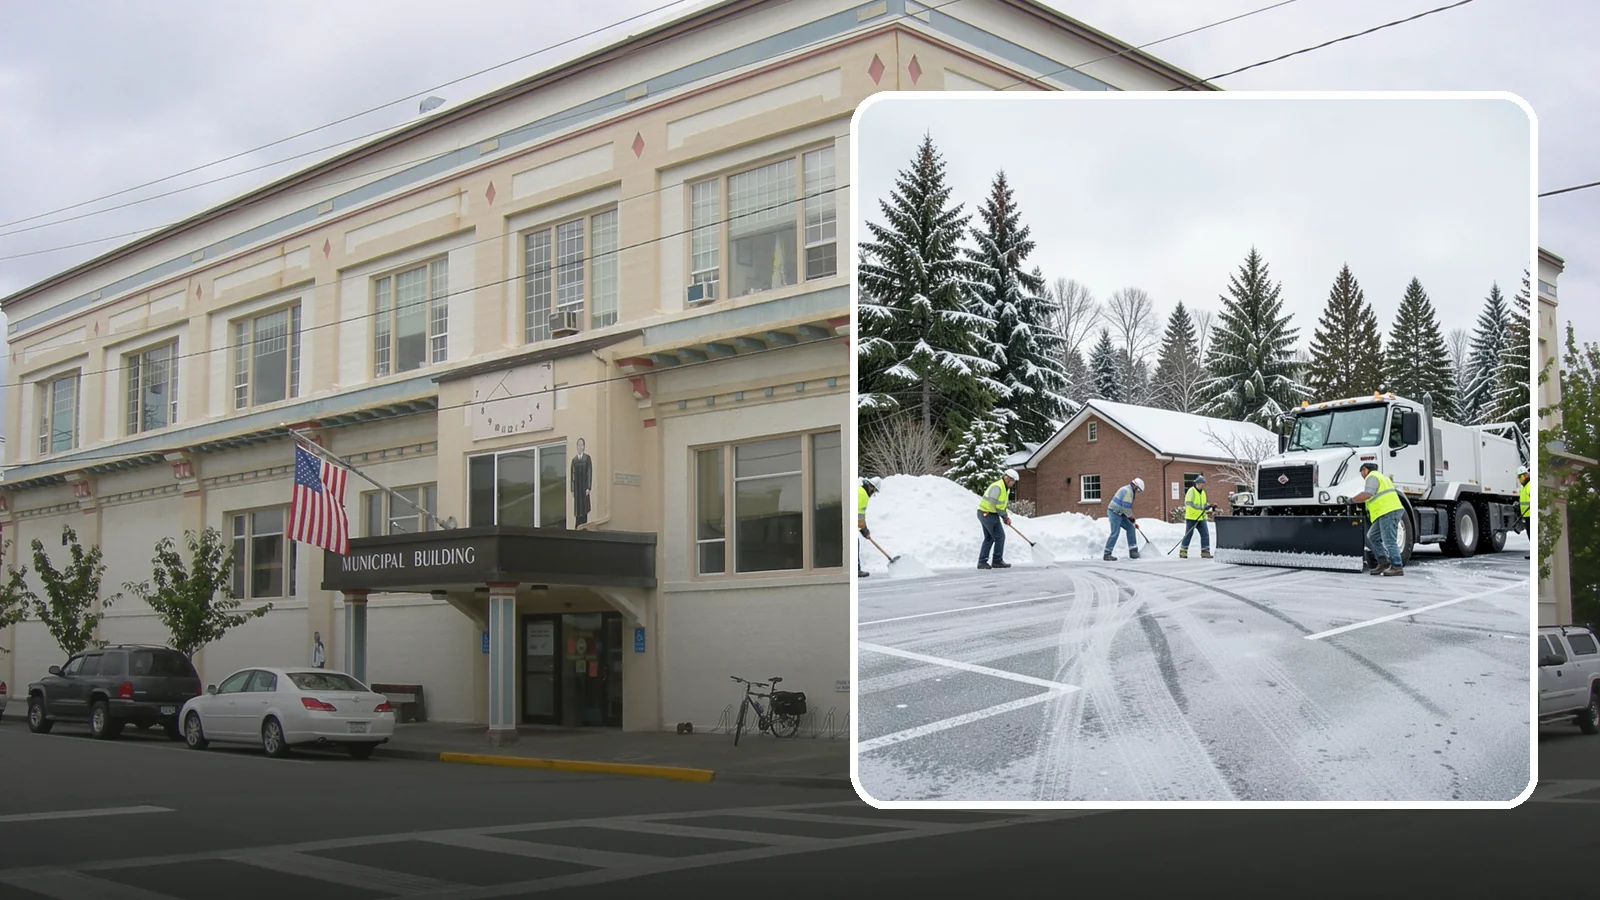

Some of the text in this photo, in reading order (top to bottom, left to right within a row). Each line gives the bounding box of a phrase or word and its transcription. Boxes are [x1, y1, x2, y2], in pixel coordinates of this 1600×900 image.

[529, 414, 533, 422] 3
[342, 546, 475, 572] MUNICIPAL BUILDING
